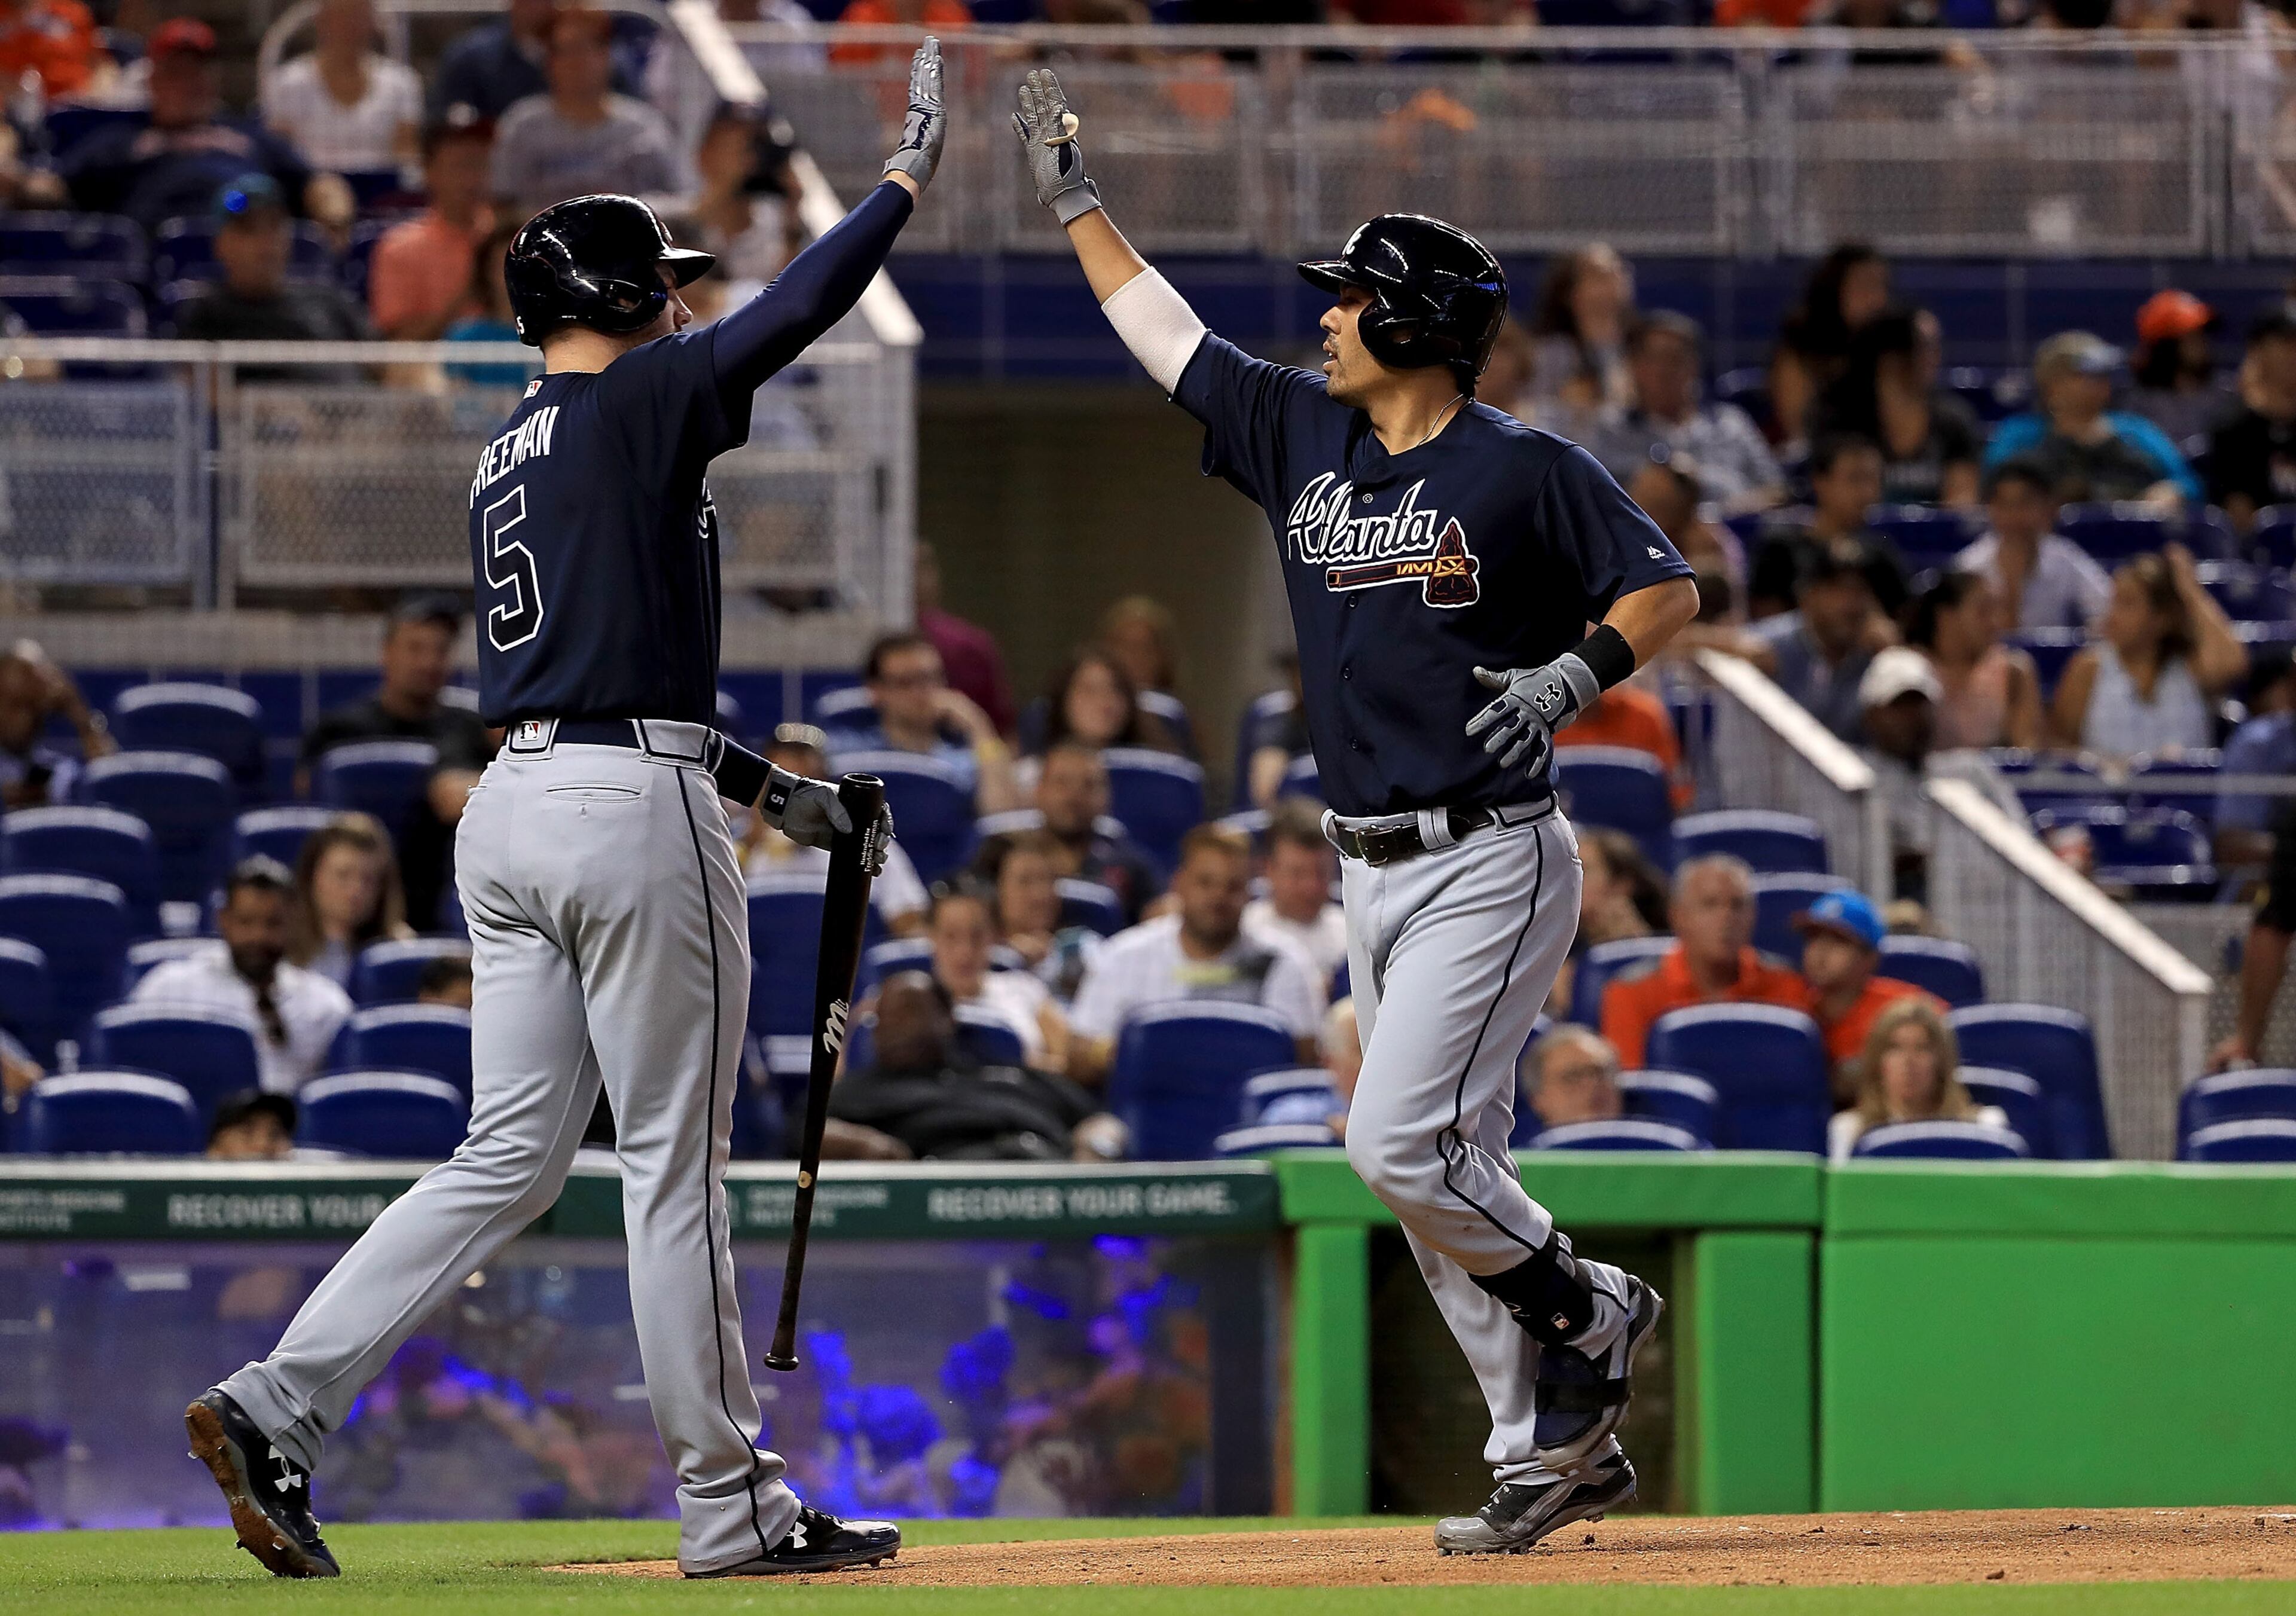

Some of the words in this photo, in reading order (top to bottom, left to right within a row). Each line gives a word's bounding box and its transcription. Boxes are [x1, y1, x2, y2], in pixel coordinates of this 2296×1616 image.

[469, 405, 560, 510] FREEMAN
[1287, 471, 1438, 564] Atlanta
[483, 483, 544, 652] 5
[771, 794, 785, 805] 5
[167, 1193, 306, 1229] RECOVER
[927, 1186, 1064, 1223] RECOVER
[1066, 1184, 1143, 1218] YOUR
